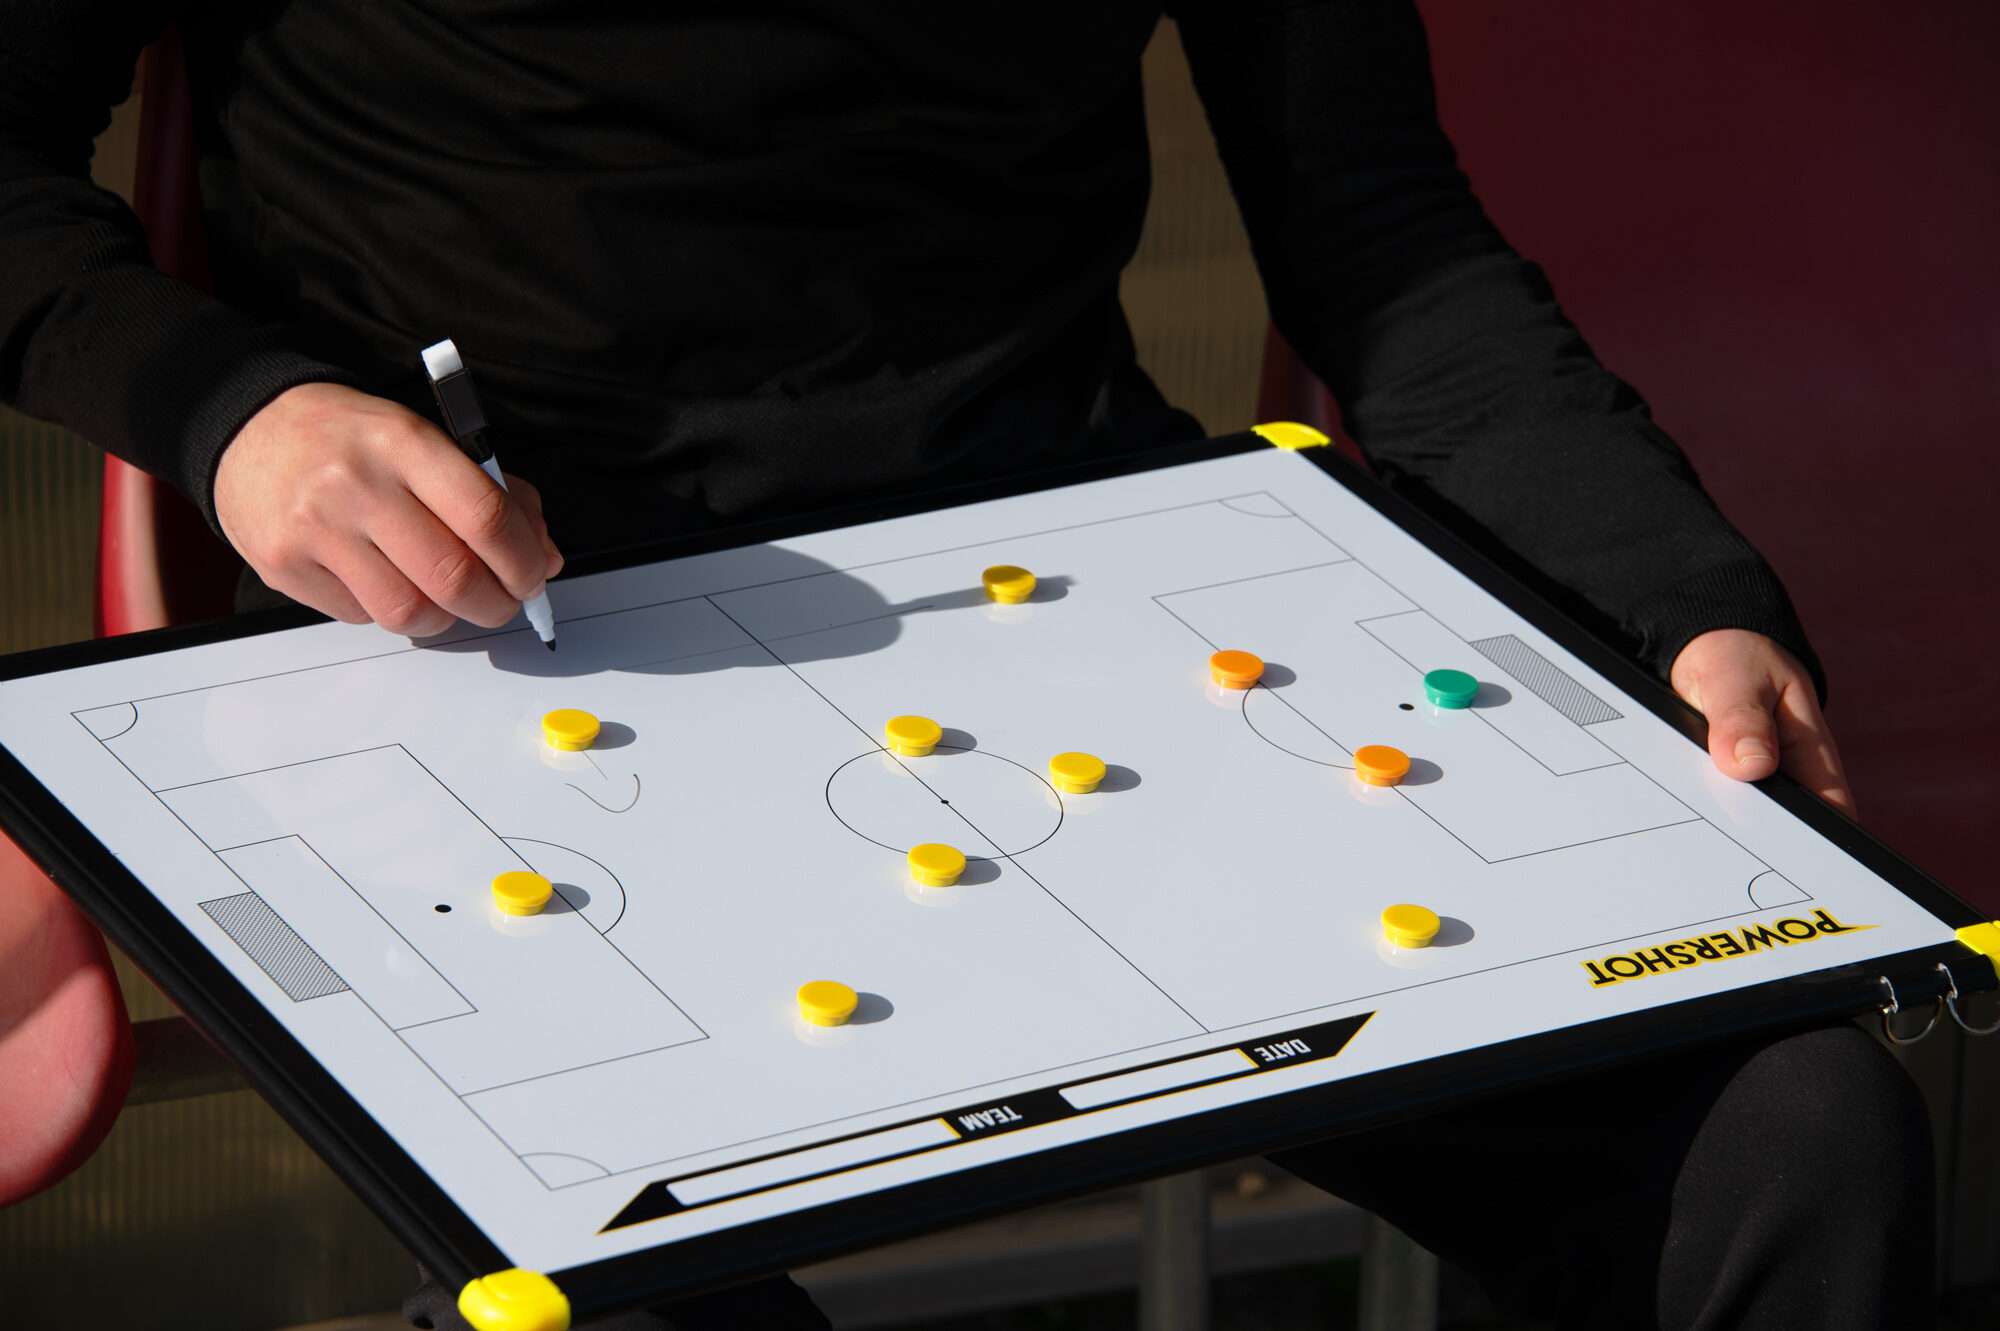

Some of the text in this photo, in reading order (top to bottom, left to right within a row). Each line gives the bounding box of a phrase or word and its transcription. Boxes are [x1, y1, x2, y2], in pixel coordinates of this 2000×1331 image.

[1584, 908, 1861, 986] POWERSHOT
[1254, 1039, 1312, 1062] DATE
[958, 1105, 1023, 1131] TEAM
